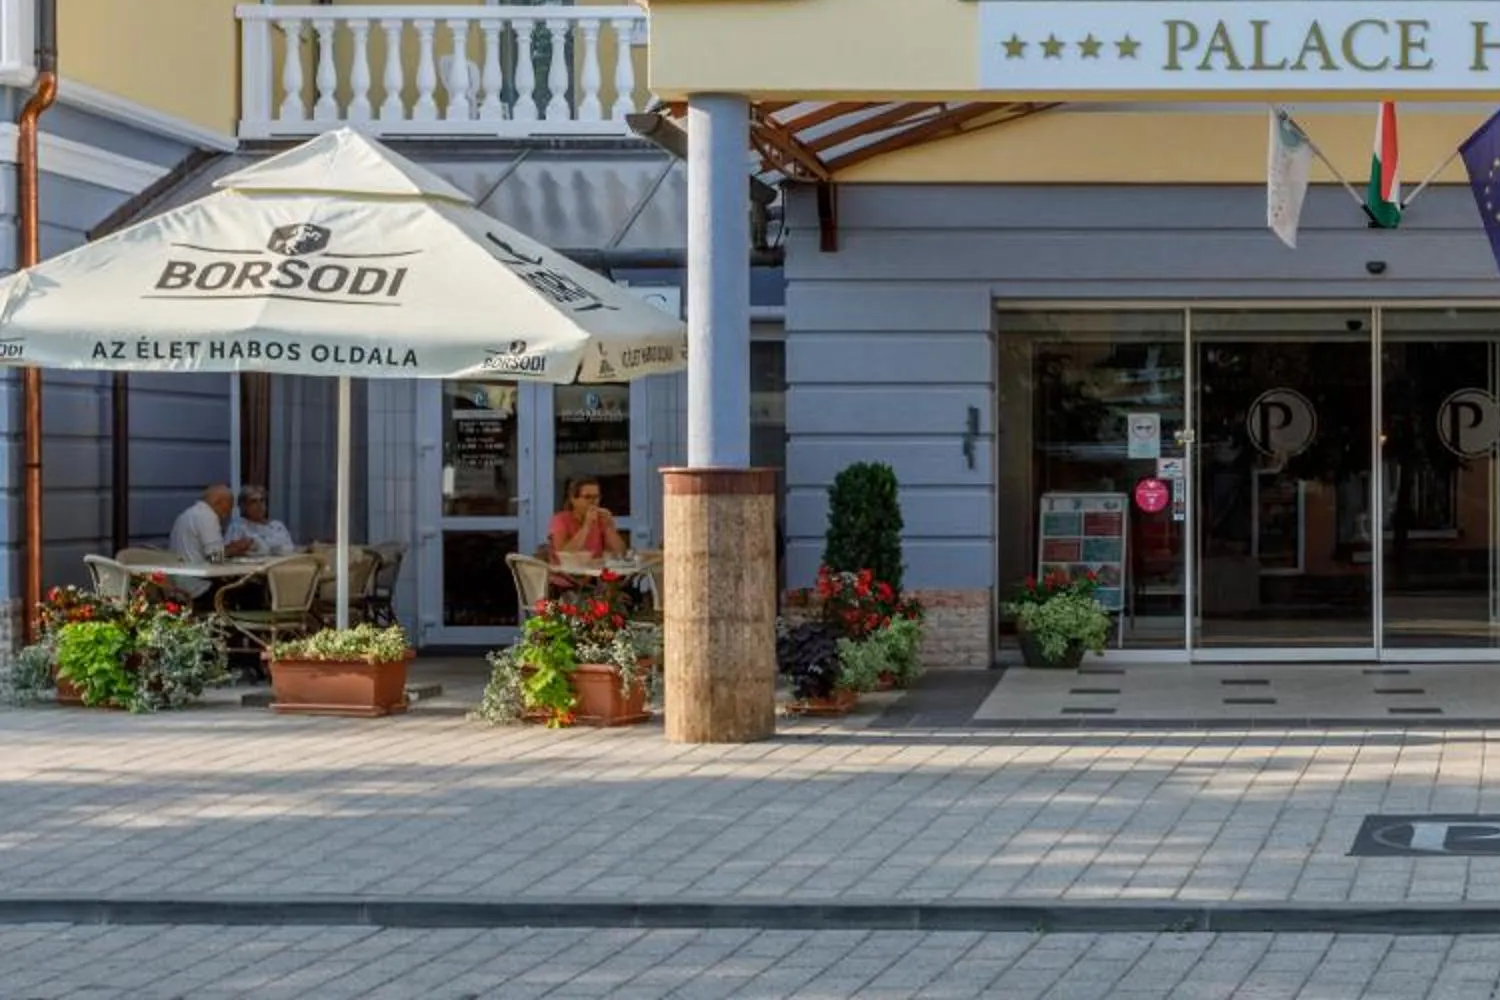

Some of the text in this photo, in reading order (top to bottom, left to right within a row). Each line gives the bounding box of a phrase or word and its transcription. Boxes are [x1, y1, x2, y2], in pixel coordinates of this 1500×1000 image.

[1161, 18, 1434, 72] PALACE
[155, 258, 408, 297] BORSODI
[91, 336, 418, 367] AZ ÉLET HABOS OLDALA
[484, 356, 547, 372] BORSODI
[1259, 401, 1293, 452] P
[1453, 401, 1483, 451] P
